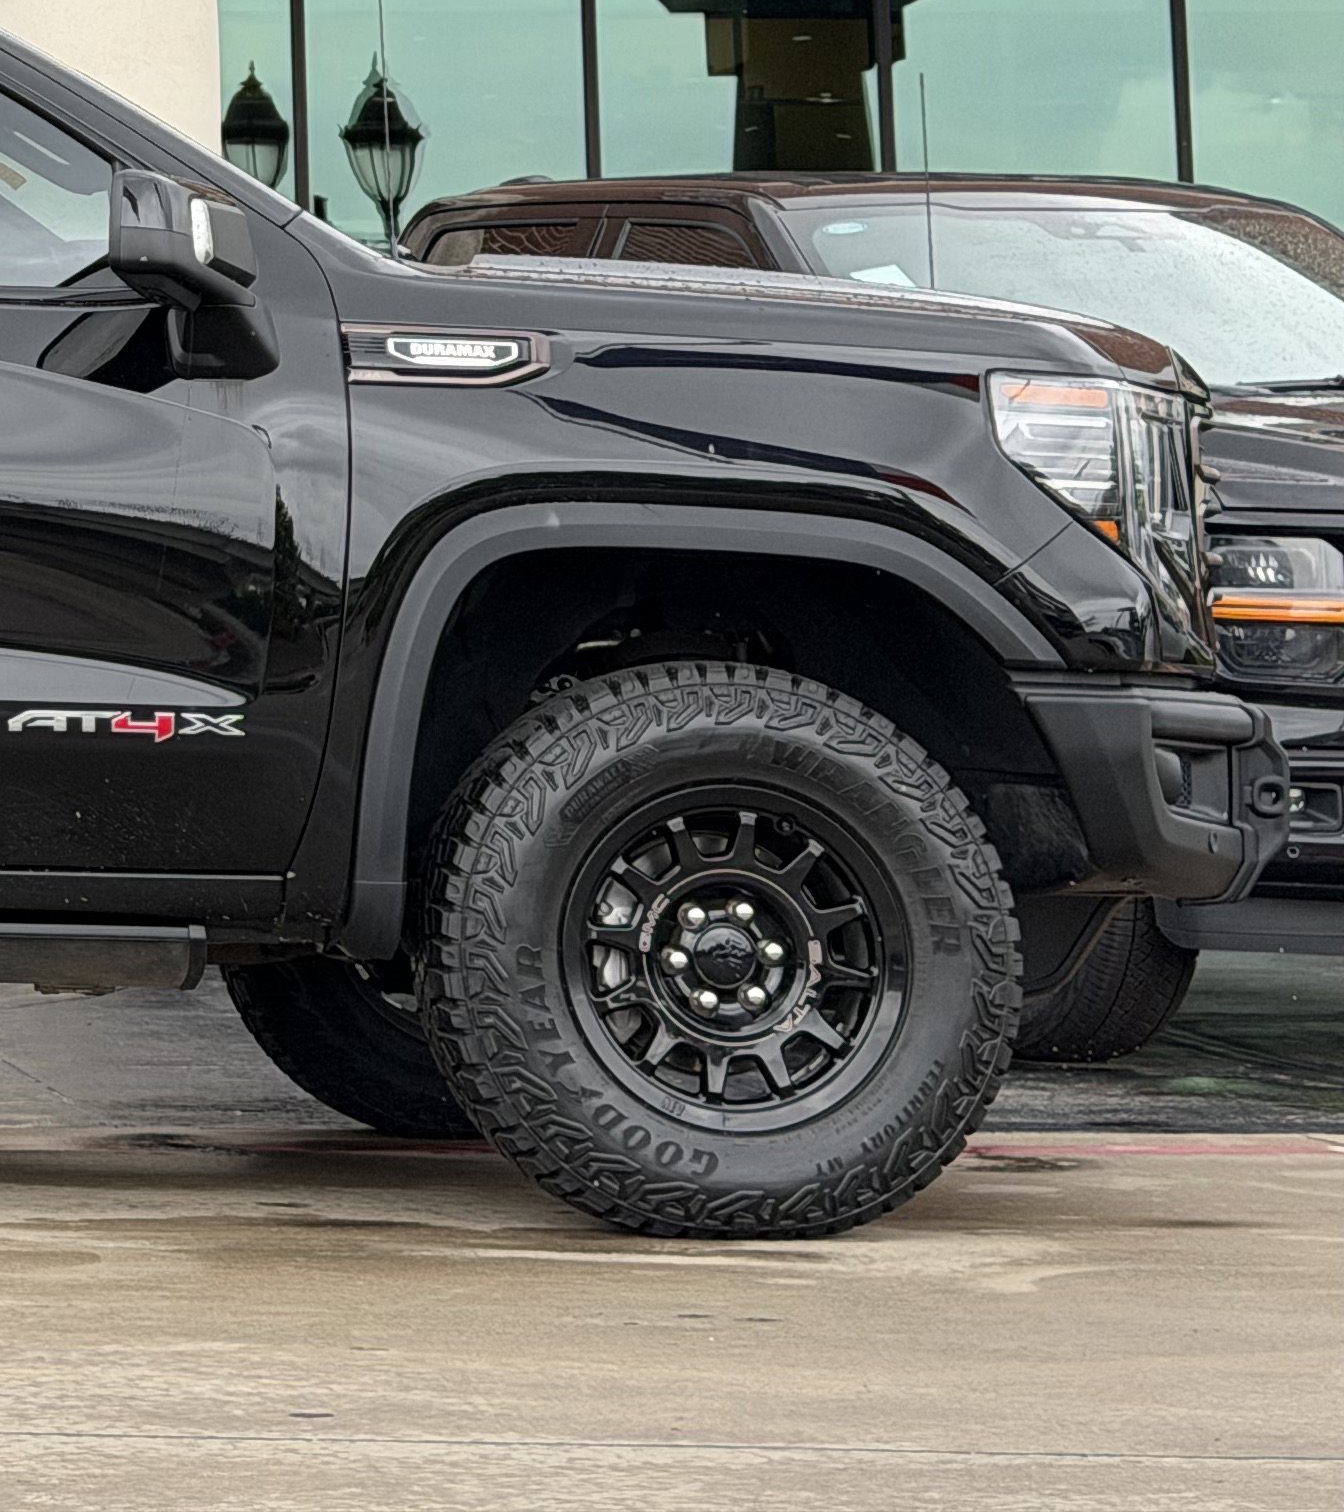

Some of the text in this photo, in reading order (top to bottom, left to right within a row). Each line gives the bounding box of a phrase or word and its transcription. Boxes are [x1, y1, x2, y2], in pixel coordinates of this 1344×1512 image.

[409, 342, 496, 358] DURAMAX
[7, 709, 246, 743] AT4X
[638, 893, 671, 953] GMC
[773, 939, 823, 1033] SALTA
